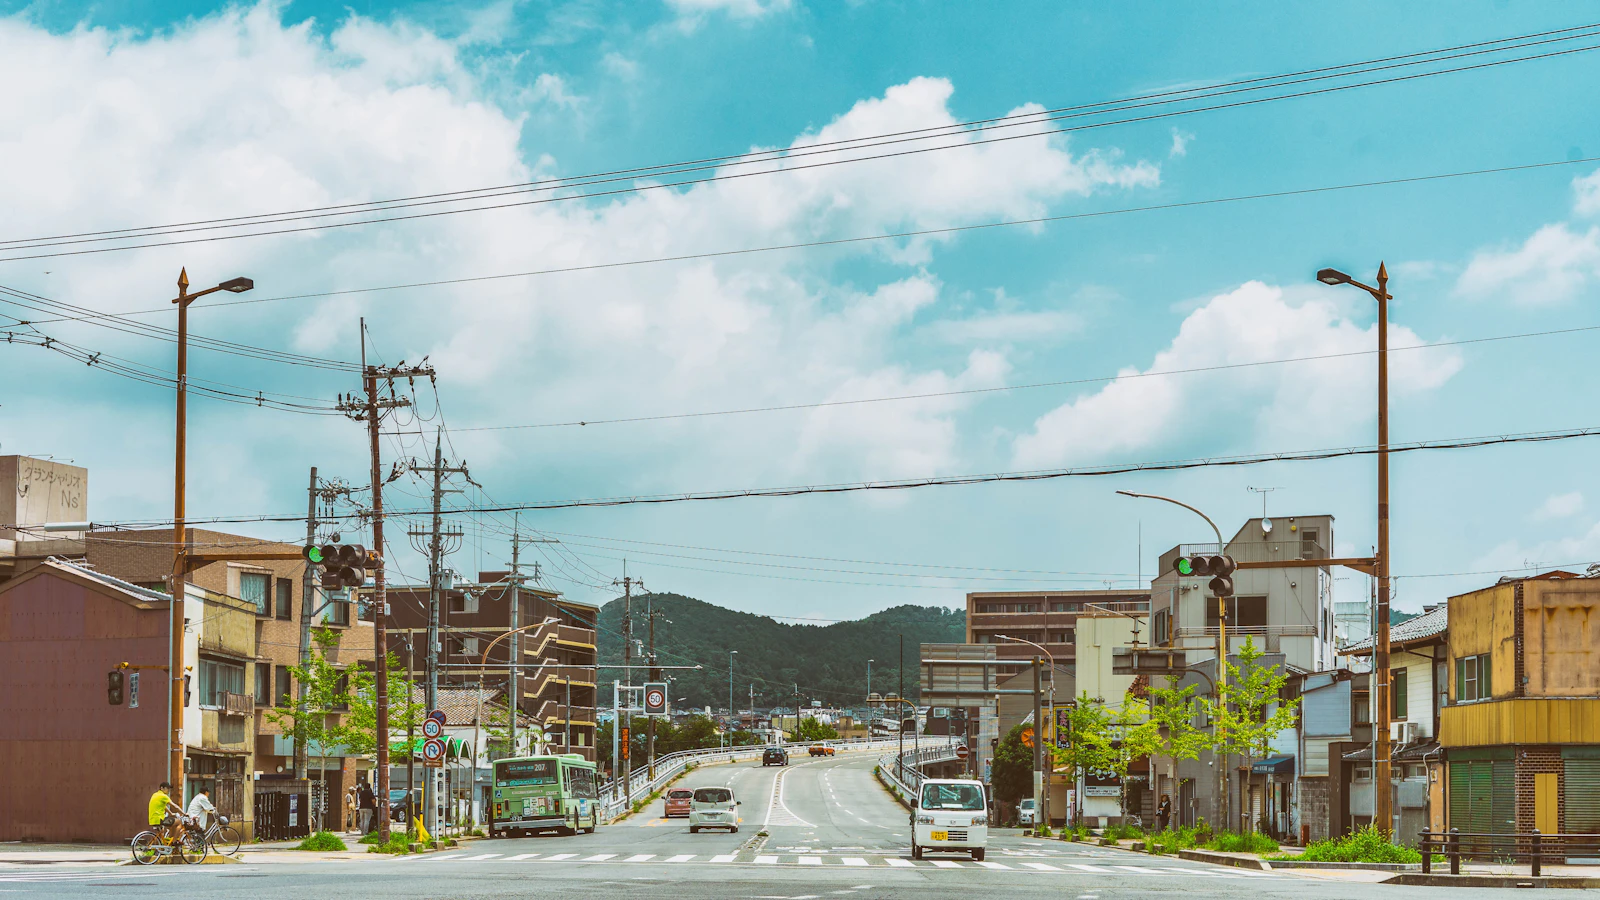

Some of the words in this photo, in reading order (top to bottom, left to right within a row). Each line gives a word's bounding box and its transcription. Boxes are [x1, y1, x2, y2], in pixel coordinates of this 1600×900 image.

[650, 695, 661, 703] 50
[426, 724, 438, 734] 50
[534, 763, 546, 772] 207
